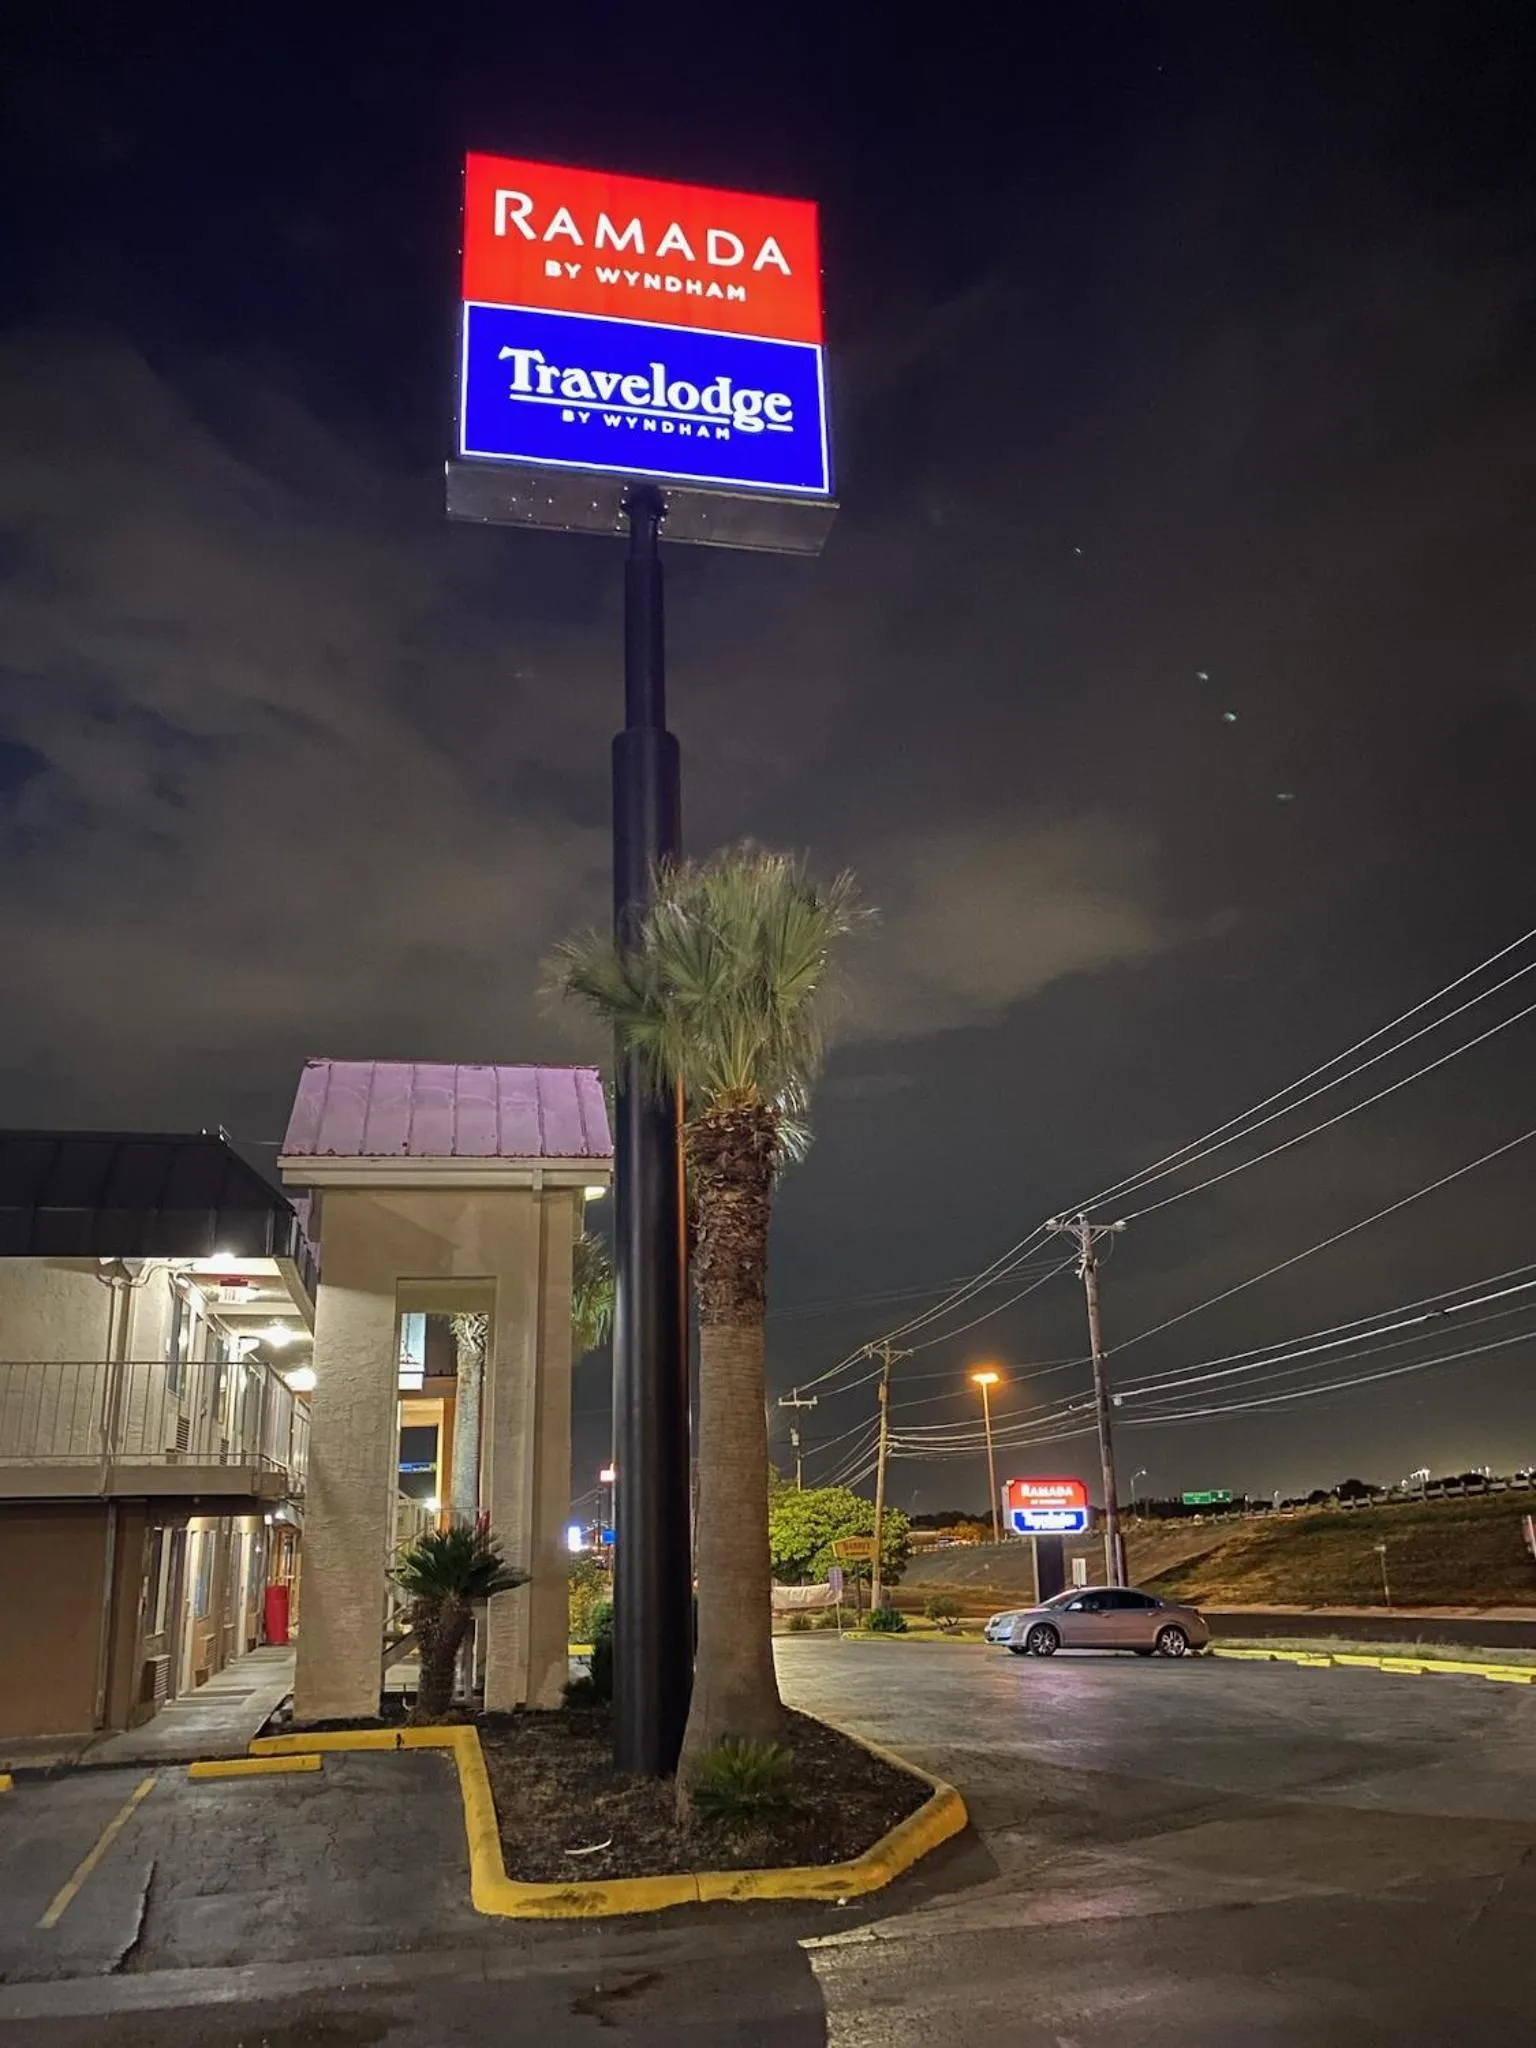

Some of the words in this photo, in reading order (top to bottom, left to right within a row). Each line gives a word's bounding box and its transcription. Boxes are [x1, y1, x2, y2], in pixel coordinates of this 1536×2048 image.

[494, 189, 792, 276] RAMADA
[544, 260, 582, 280] BY
[595, 266, 747, 303] WYNDHAM
[498, 346, 795, 434] Travelodge
[562, 408, 591, 424] BY
[603, 414, 731, 441] WYNDHAM
